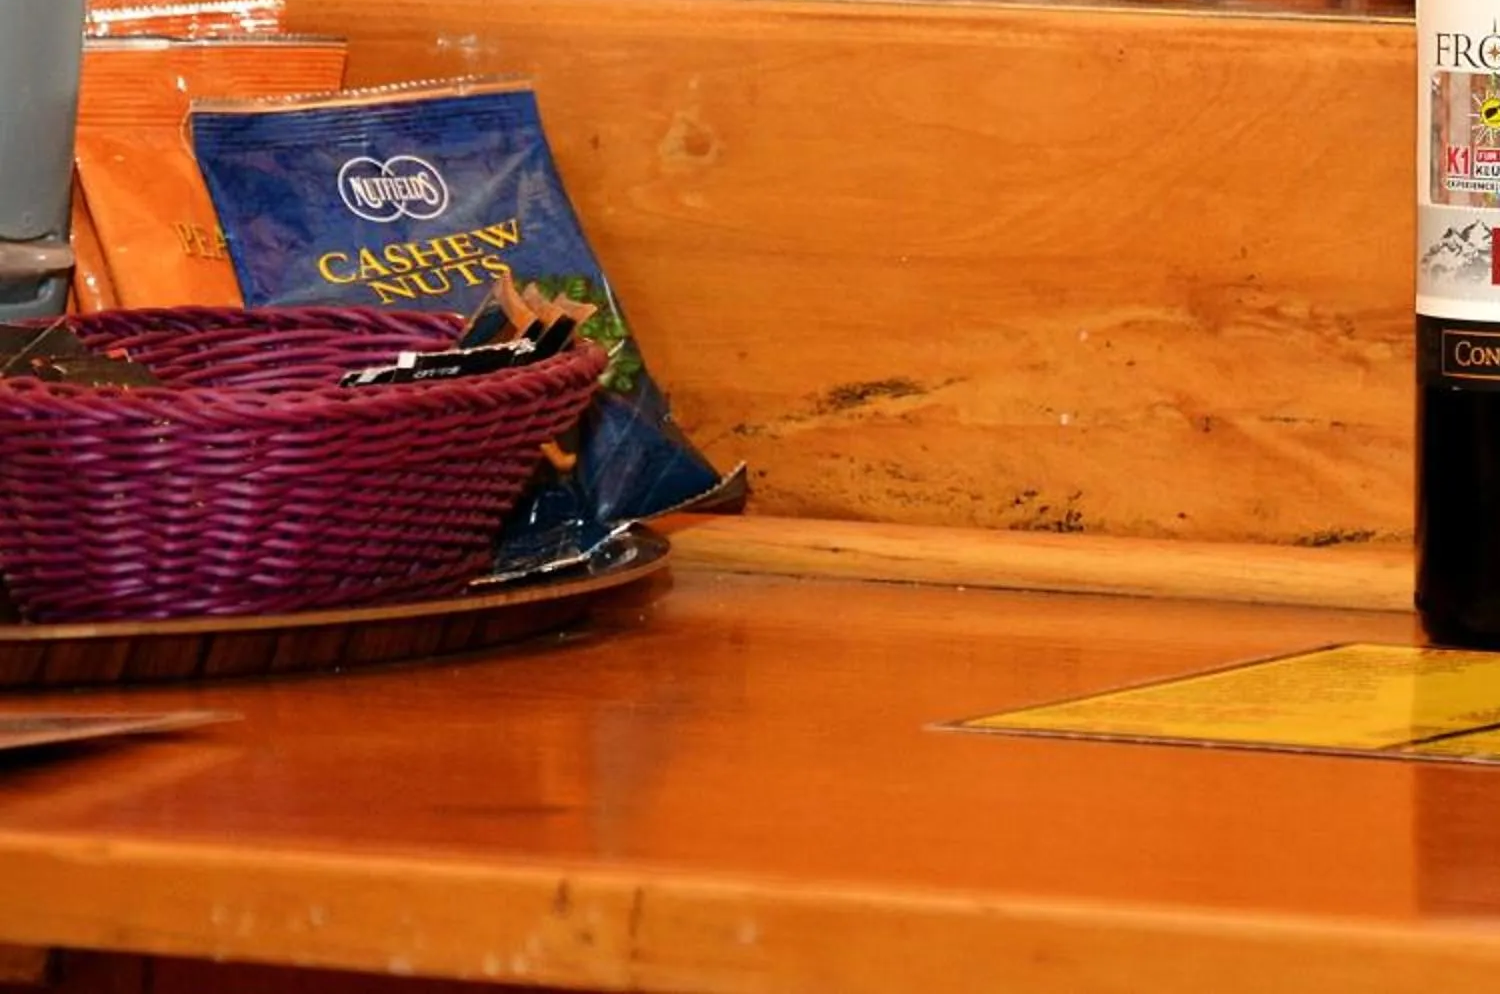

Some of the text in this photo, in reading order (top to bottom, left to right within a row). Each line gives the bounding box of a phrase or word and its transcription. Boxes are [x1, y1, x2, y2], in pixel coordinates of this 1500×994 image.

[1447, 145, 1470, 175] K1
[349, 172, 439, 208] NUTFIELDS
[318, 217, 522, 284] CASHEW
[367, 254, 511, 305] NUTS
